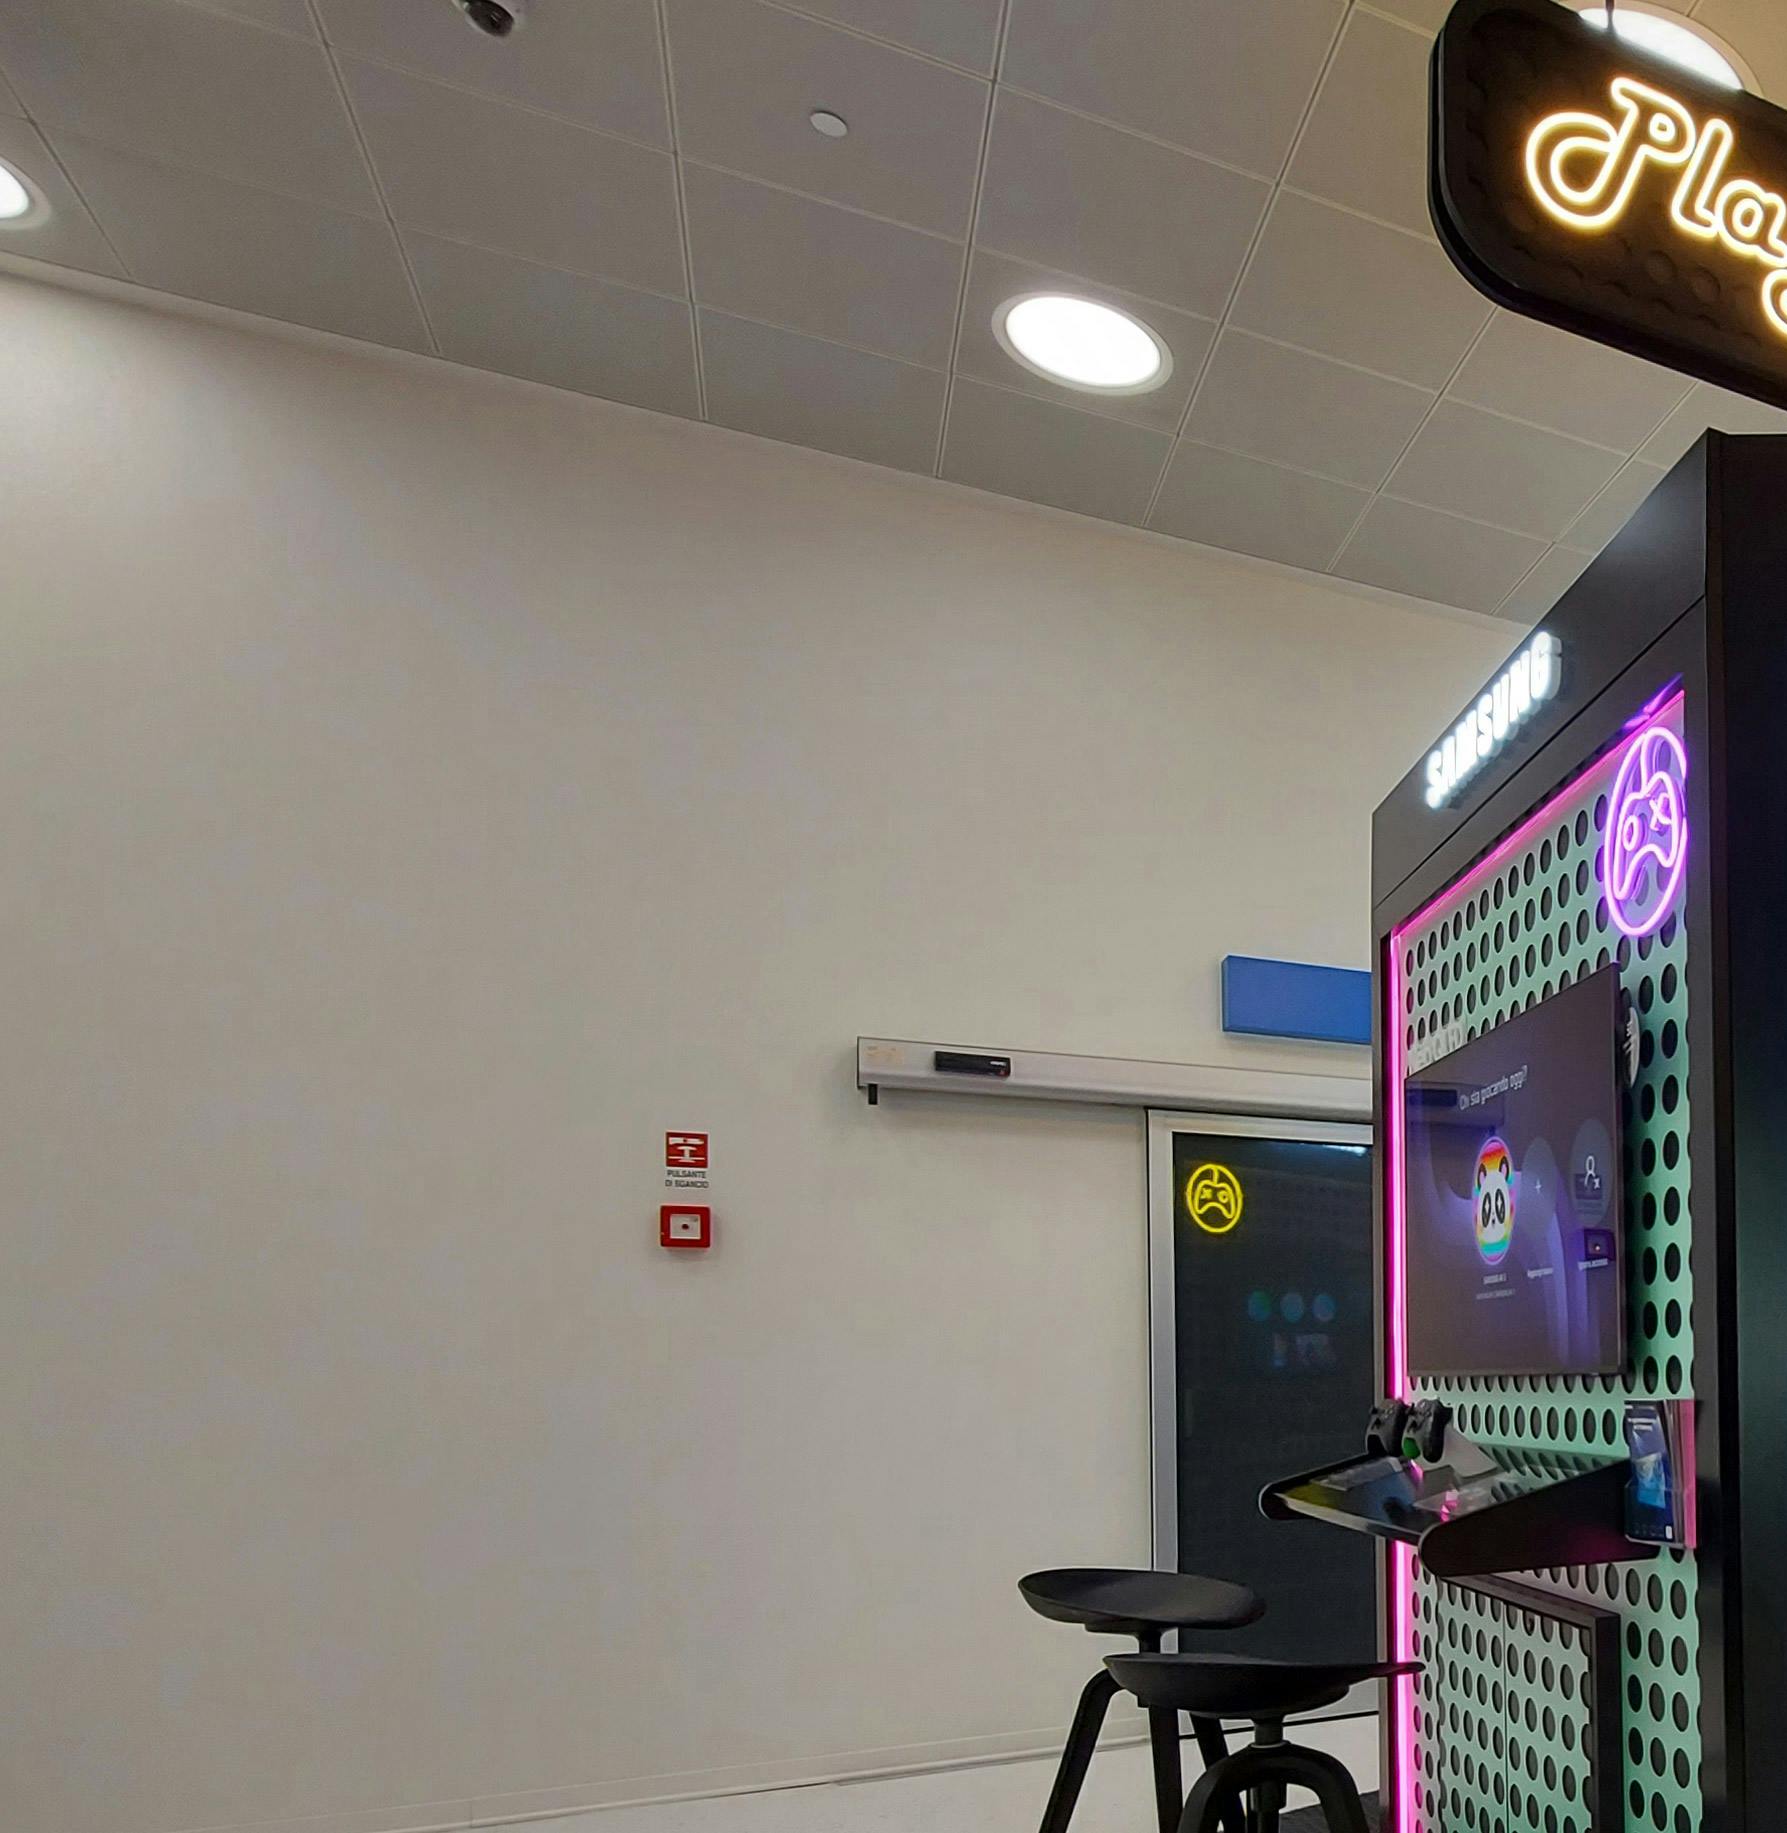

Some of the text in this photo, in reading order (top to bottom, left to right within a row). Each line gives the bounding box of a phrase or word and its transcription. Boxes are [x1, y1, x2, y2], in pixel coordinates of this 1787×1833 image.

[1425, 630, 1562, 811] SAMSUNG
[667, 1169, 706, 1178] PULSANTE
[664, 1179, 672, 1187] DI
